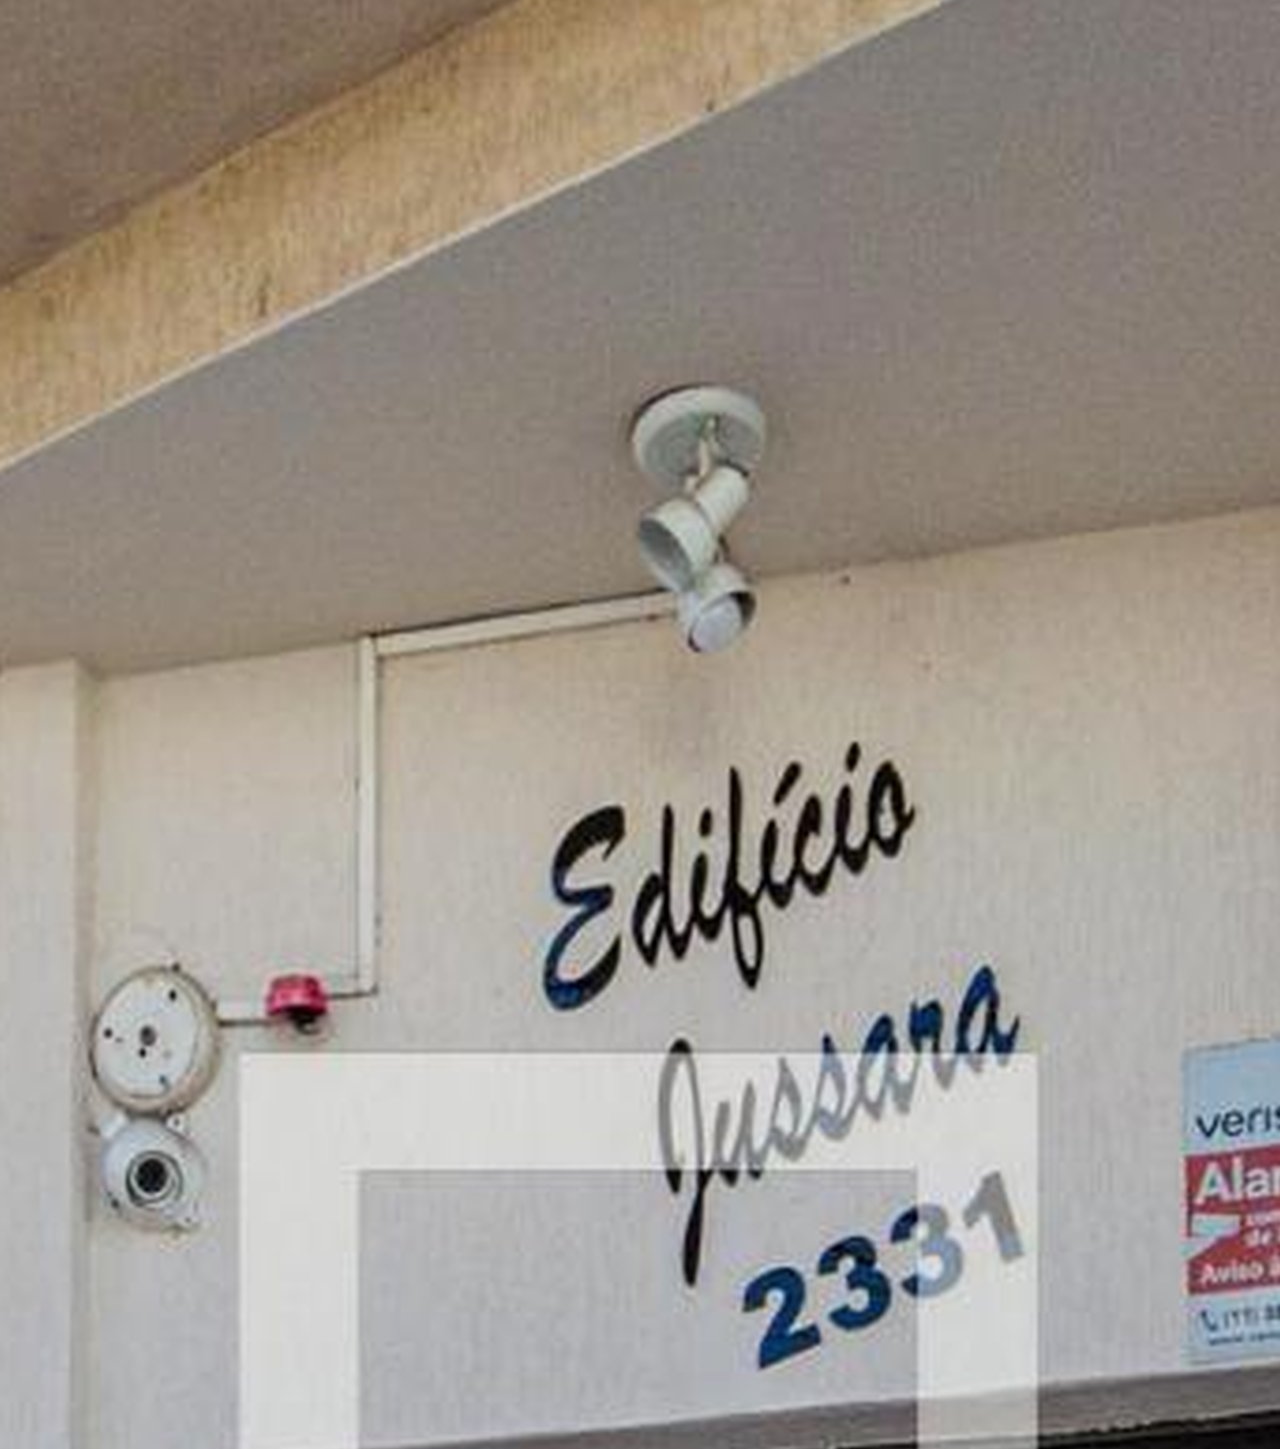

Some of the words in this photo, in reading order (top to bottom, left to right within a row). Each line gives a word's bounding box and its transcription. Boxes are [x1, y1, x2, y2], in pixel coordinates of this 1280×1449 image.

[542, 741, 915, 1011] Edifício
[658, 964, 1021, 1288] Jussara
[742, 1170, 1024, 1370] 2331
[1199, 1260, 1264, 1285] Aviso
